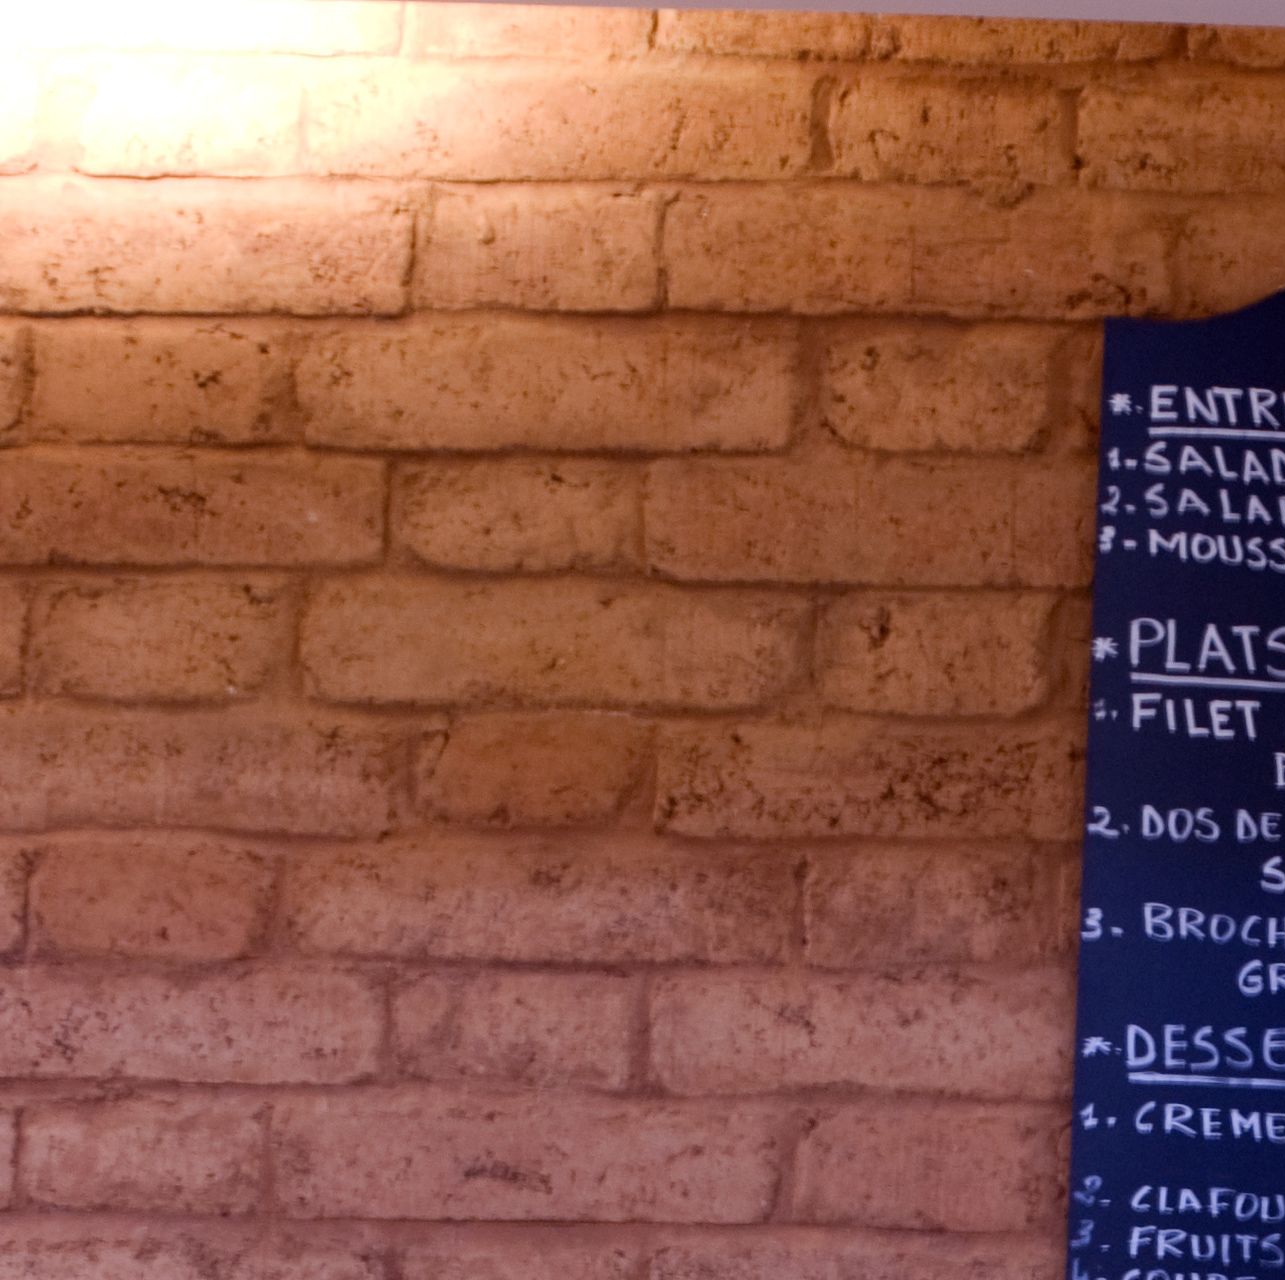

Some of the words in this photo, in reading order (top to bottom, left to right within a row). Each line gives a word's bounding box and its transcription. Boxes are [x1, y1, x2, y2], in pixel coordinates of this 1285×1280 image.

[1131, 693, 1261, 742] FILET
[1141, 804, 1221, 843] DOS
[1236, 808, 1283, 842] DE
[1128, 1225, 1285, 1268] FRUITS
